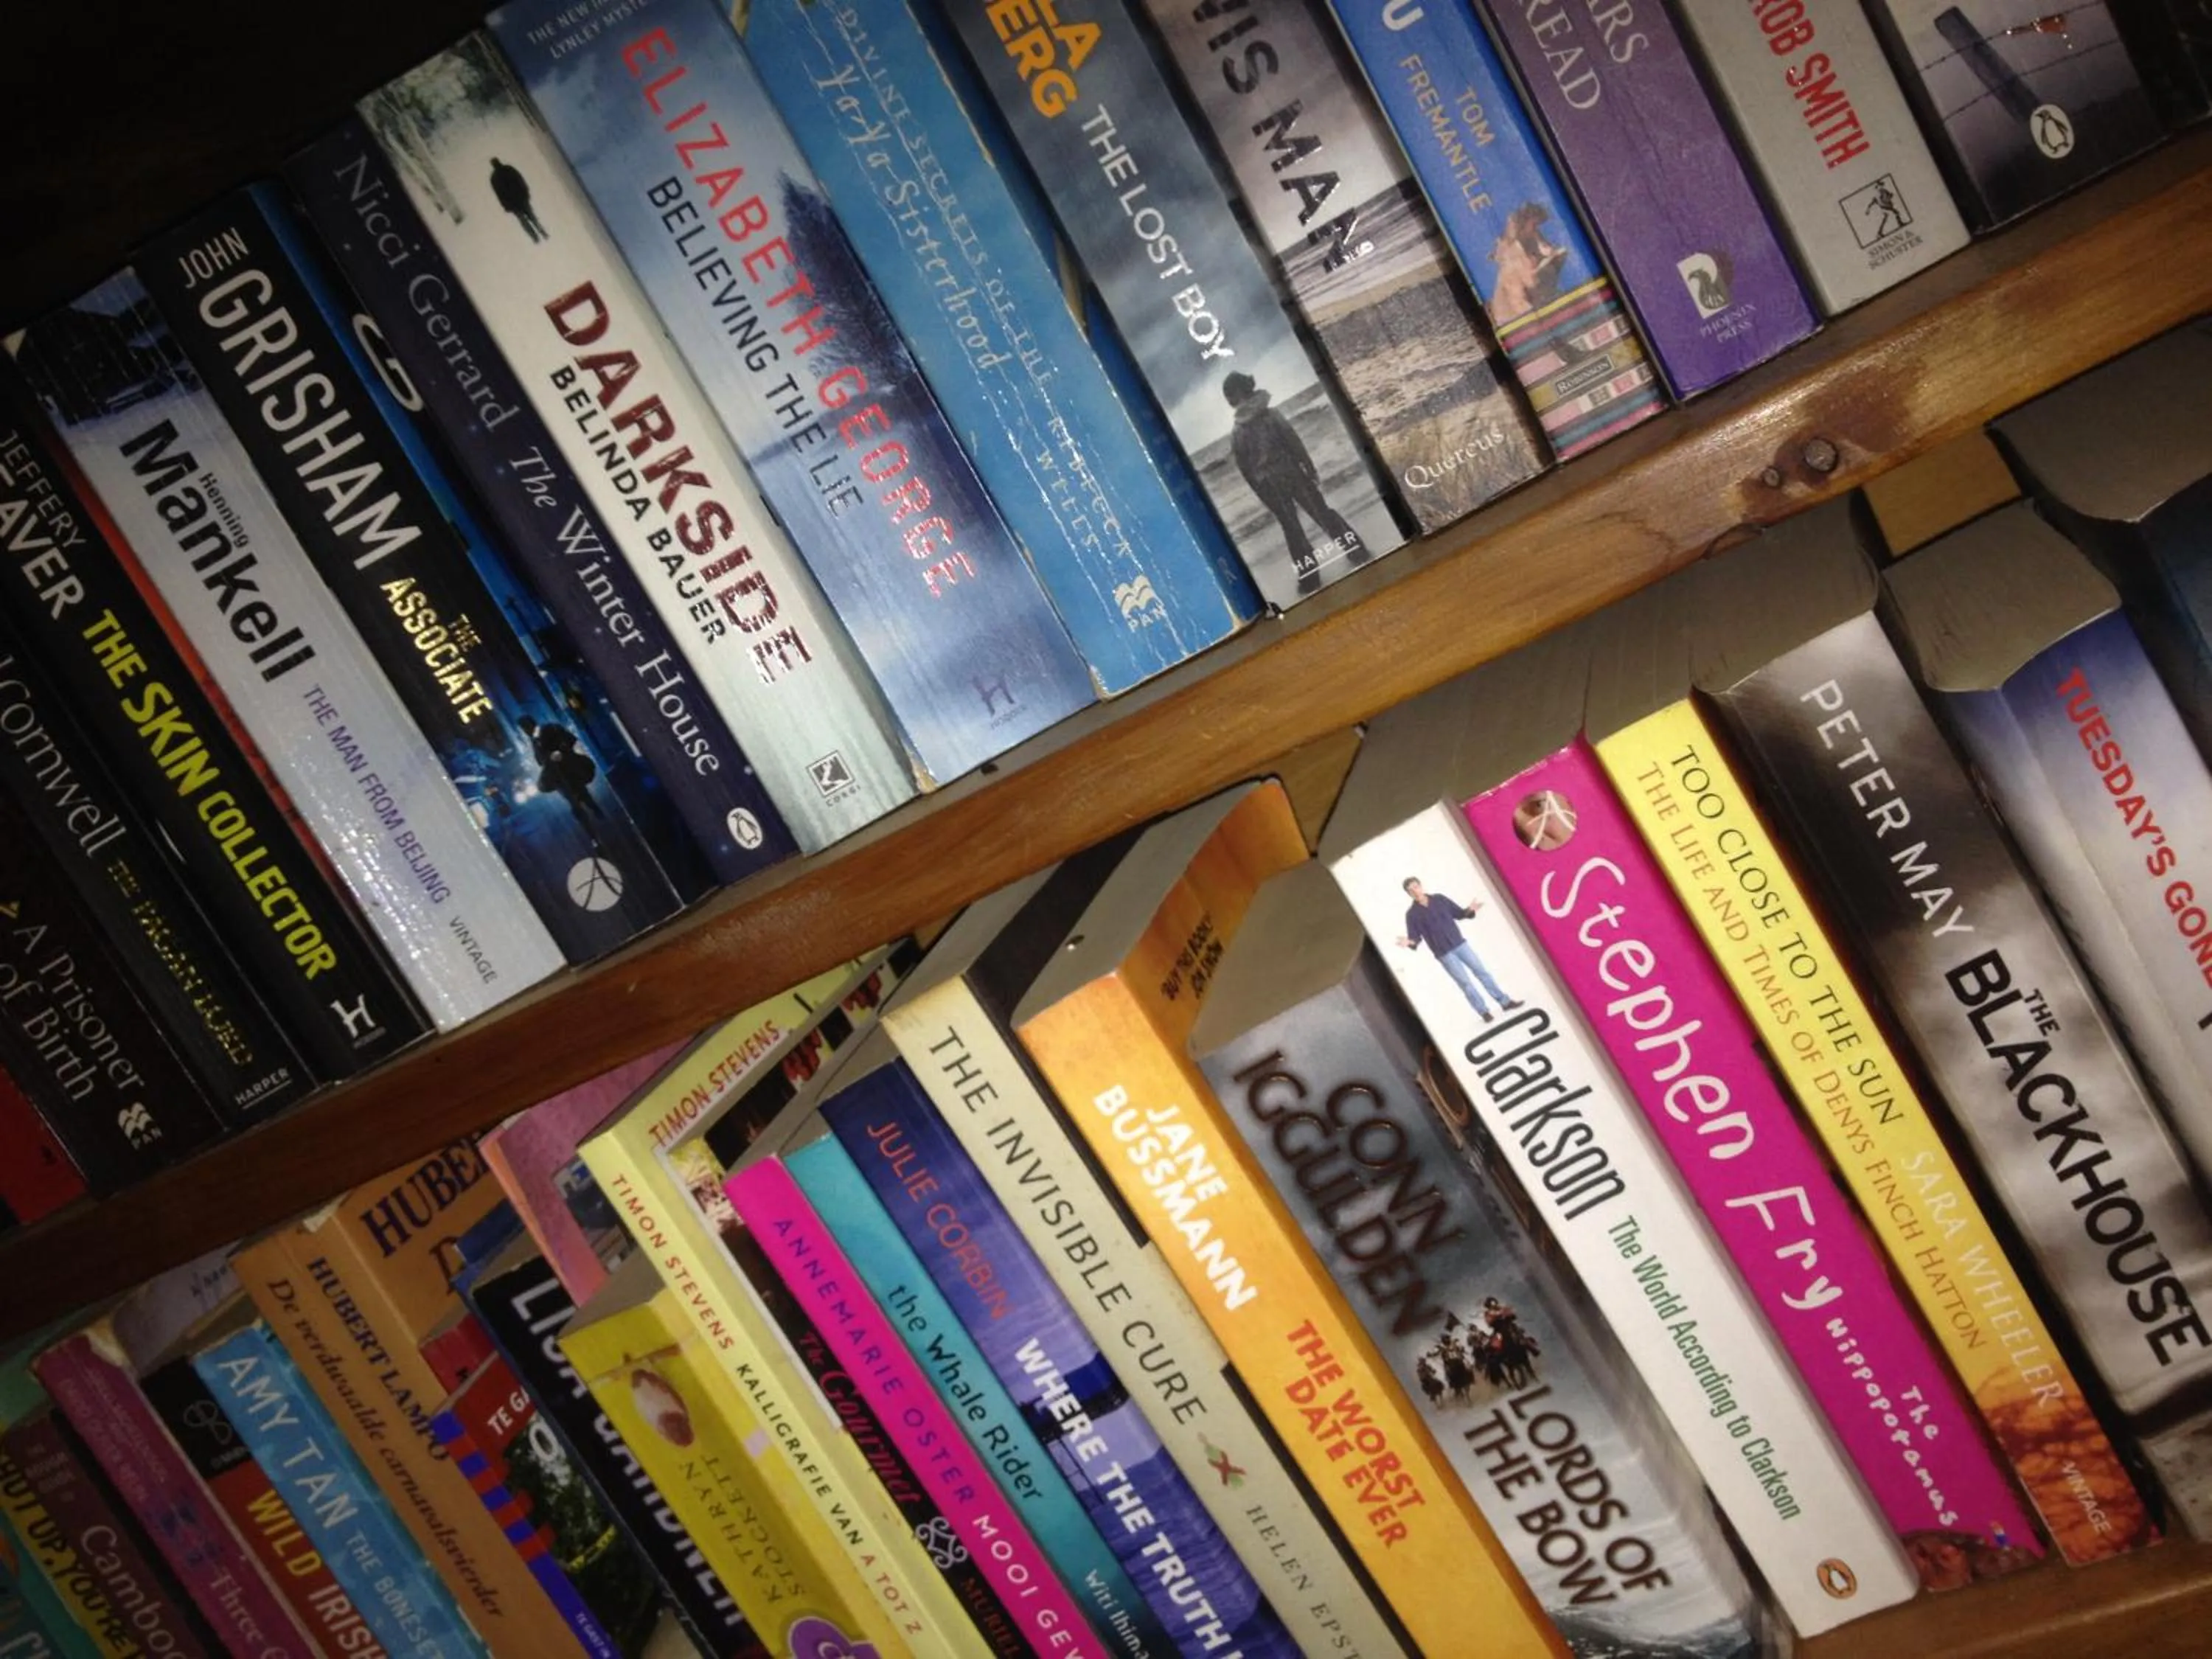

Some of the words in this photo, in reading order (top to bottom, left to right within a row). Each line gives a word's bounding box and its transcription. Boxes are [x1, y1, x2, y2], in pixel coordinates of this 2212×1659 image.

[527, 20, 557, 44] THE
[556, 4, 591, 28] NEW
[549, 21, 603, 60] LYNLEY
[1785, 52, 1871, 170] SMITH
[841, 9, 911, 120] DIVINE
[911, 136, 990, 267] SECRETS
[985, 278, 1016, 313] OF
[1013, 331, 1054, 386] THE
[1252, 99, 1358, 274] MAN
[1399, 53, 1495, 215] FREMANTLE
[1455, 84, 1496, 148] TOM
[177, 227, 250, 290] JOHN
[621, 26, 837, 359] ELIZABETH
[816, 364, 977, 599] GEORGE
[886, 178, 1015, 369] Sisterhood
[1082, 105, 1138, 188] THE
[1119, 183, 1194, 280] LOST
[1171, 282, 1237, 361] BOY
[198, 269, 422, 571] GRISHAM
[647, 175, 779, 372] BELIEVING
[765, 372, 827, 455] THE
[808, 454, 864, 518] LIE
[0, 429, 88, 549] JEFFERY
[0, 462, 86, 621] AVER
[198, 472, 250, 548] Henning
[334, 150, 410, 269] Nicci
[408, 273, 520, 432] Gerrard
[509, 445, 560, 509] The
[555, 504, 645, 648] Winter
[636, 651, 722, 776] House
[543, 280, 812, 689] DARKSIDE
[550, 364, 652, 522] BELINDA
[646, 528, 728, 645] BAUER
[1037, 451, 1099, 551] WELLS
[1047, 417, 1131, 557] REBECCA
[1404, 422, 1507, 492] Quercus
[119, 418, 316, 682] Mankell
[448, 613, 483, 655] THE
[1127, 600, 1166, 633] PAN
[1290, 531, 1359, 574] HARPER
[380, 577, 495, 725] ASSOCIATE
[83, 608, 148, 690] THE
[121, 681, 220, 799] SKIN
[197, 790, 338, 981] COLLECTOR
[302, 684, 340, 732] THE
[326, 725, 369, 774] MAN
[358, 765, 406, 832] FROM
[395, 830, 452, 905] BEIJING
[826, 784, 861, 807] CORGI
[1800, 679, 1913, 838] PETER
[1891, 841, 1975, 939] MAY
[2057, 667, 2178, 880] TUESDAY'S
[13, 923, 49, 954] A
[39, 943, 145, 1091] Prisoner
[448, 915, 498, 985] VINTAGE
[1671, 744, 1725, 819] TOO
[1717, 828, 1791, 930] CLOSE
[1779, 931, 1819, 981] TO
[1809, 985, 1863, 1054] THE
[1848, 1058, 1904, 1126] SUN
[2023, 988, 2062, 1037] THE
[22, 1006, 97, 1101] Birth
[234, 1066, 291, 1105] HARPER
[649, 1083, 712, 1149] TIMON
[708, 1019, 781, 1093] STEVENS
[1541, 857, 1755, 1160] Stephen
[1725, 1186, 1843, 1310] Fry
[1638, 761, 1680, 821] THE
[1670, 823, 1717, 880] LIFE
[1703, 886, 1750, 943] AND
[1743, 943, 1801, 1027] TIMES
[1790, 1031, 1825, 1073] OF
[1812, 1069, 1876, 1156] DENYS
[1865, 1158, 1924, 1242] FINCH
[1914, 1247, 1990, 1351] HATTON
[1091, 1084, 1259, 1313] BUSSMANN
[1146, 1103, 1230, 1204] JANE
[1232, 1050, 1444, 1338] IGGULDEN
[1327, 1082, 1466, 1254] CONN
[1945, 949, 2212, 1368] BLACKHOUSE
[928, 1025, 1000, 1114] THE
[987, 1117, 1134, 1315] INVISIBLE
[1121, 1319, 1208, 1425] CURE
[1245, 1504, 1314, 1595] HELEN
[1464, 1007, 1627, 1222] Clarkson
[1608, 1215, 1643, 1260] The
[1632, 1254, 1688, 1321] World
[1667, 1319, 1739, 1420] According
[1726, 1413, 1753, 1439] to
[1741, 1437, 1803, 1523] Clarkson
[1901, 1150, 1970, 1242] SARA
[1958, 1244, 2066, 1410] WHEELER
[307, 1256, 391, 1370] HUBERT
[385, 1377, 450, 1462] LAMPO
[487, 1405, 515, 1436] TE
[611, 1173, 668, 1251] TIMON
[665, 1256, 734, 1352] STEVENS
[737, 1362, 833, 1499] KALLIGRAFIE
[830, 1502, 864, 1546] VAN
[860, 1554, 875, 1568] A
[875, 1572, 911, 1615] TOT
[905, 1620, 922, 1636] Z
[773, 1217, 903, 1395] ANNEMARIE
[902, 1405, 975, 1506] OSTER
[972, 1514, 1039, 1598] MOOI
[818, 1370, 922, 1504] Gourmet
[865, 1121, 942, 1205] JULIE
[927, 1200, 1017, 1321] CORBIN
[1014, 1337, 1110, 1464] WHERE
[1096, 1461, 1155, 1535] THE
[1141, 1531, 1234, 1653] TRUTH
[888, 1284, 928, 1332] the
[981, 1423, 1045, 1500] Rider
[1287, 1319, 1346, 1388] THE
[1330, 1388, 1427, 1511] WORST
[1826, 1317, 1959, 1527] Hippopotamus
[1900, 1385, 1940, 1440] The
[217, 1354, 299, 1435] AMY
[282, 1437, 360, 1531] TAN
[346, 1530, 383, 1573] THE
[246, 1488, 323, 1577] WILD
[267, 1277, 298, 1313] De
[295, 1316, 384, 1443] verdwaalde
[380, 1447, 504, 1617] carnavalsvierder
[679, 1460, 784, 1604] KATHRYN
[700, 1453, 806, 1598] STOCKETT
[1285, 1375, 1355, 1463] DATE
[1344, 1464, 1409, 1550] EVER
[1464, 1408, 1545, 1503] THE
[1517, 1503, 1618, 1607] BOW
[1509, 1385, 1630, 1532] LORDS
[1604, 1537, 1673, 1593] OF
[2061, 1461, 2114, 1535] VINTAGE
[210, 1571, 265, 1643] Three
